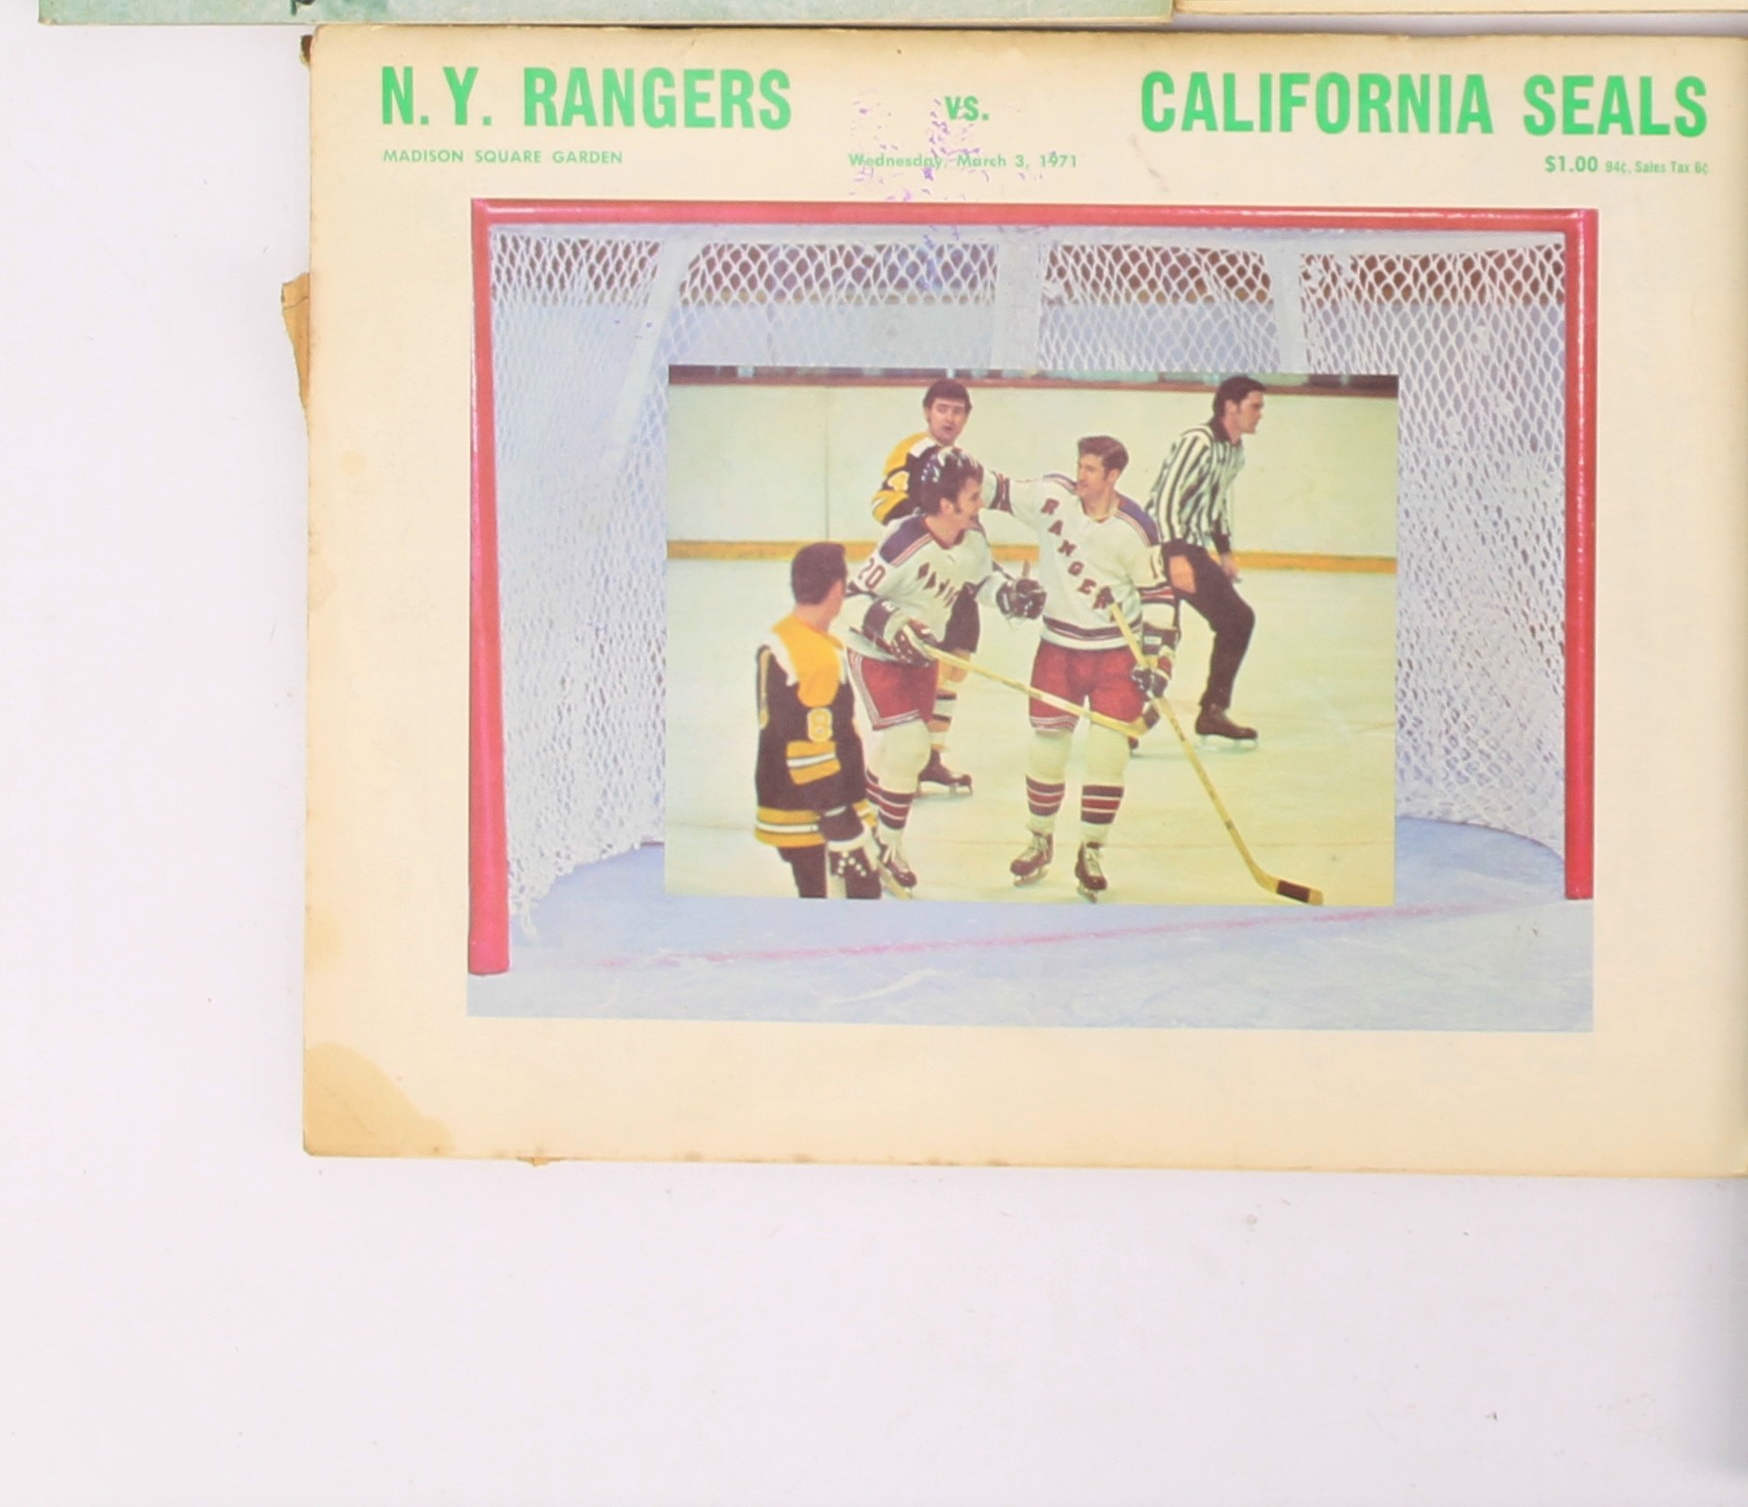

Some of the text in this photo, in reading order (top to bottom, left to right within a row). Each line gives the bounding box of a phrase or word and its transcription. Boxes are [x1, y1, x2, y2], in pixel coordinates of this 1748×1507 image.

[523, 66, 792, 131] RANGERS
[1140, 70, 1709, 139] CALIFORNIA SEALS
[383, 149, 623, 165] MADISON SQUARE GARDEN
[848, 153, 1077, 170] Wednesday, March 3, 1971
[1544, 154, 1599, 174] $1.00
[1635, 161, 1666, 174] Sales
[1670, 161, 1690, 174] Tax
[806, 706, 834, 743] 8
